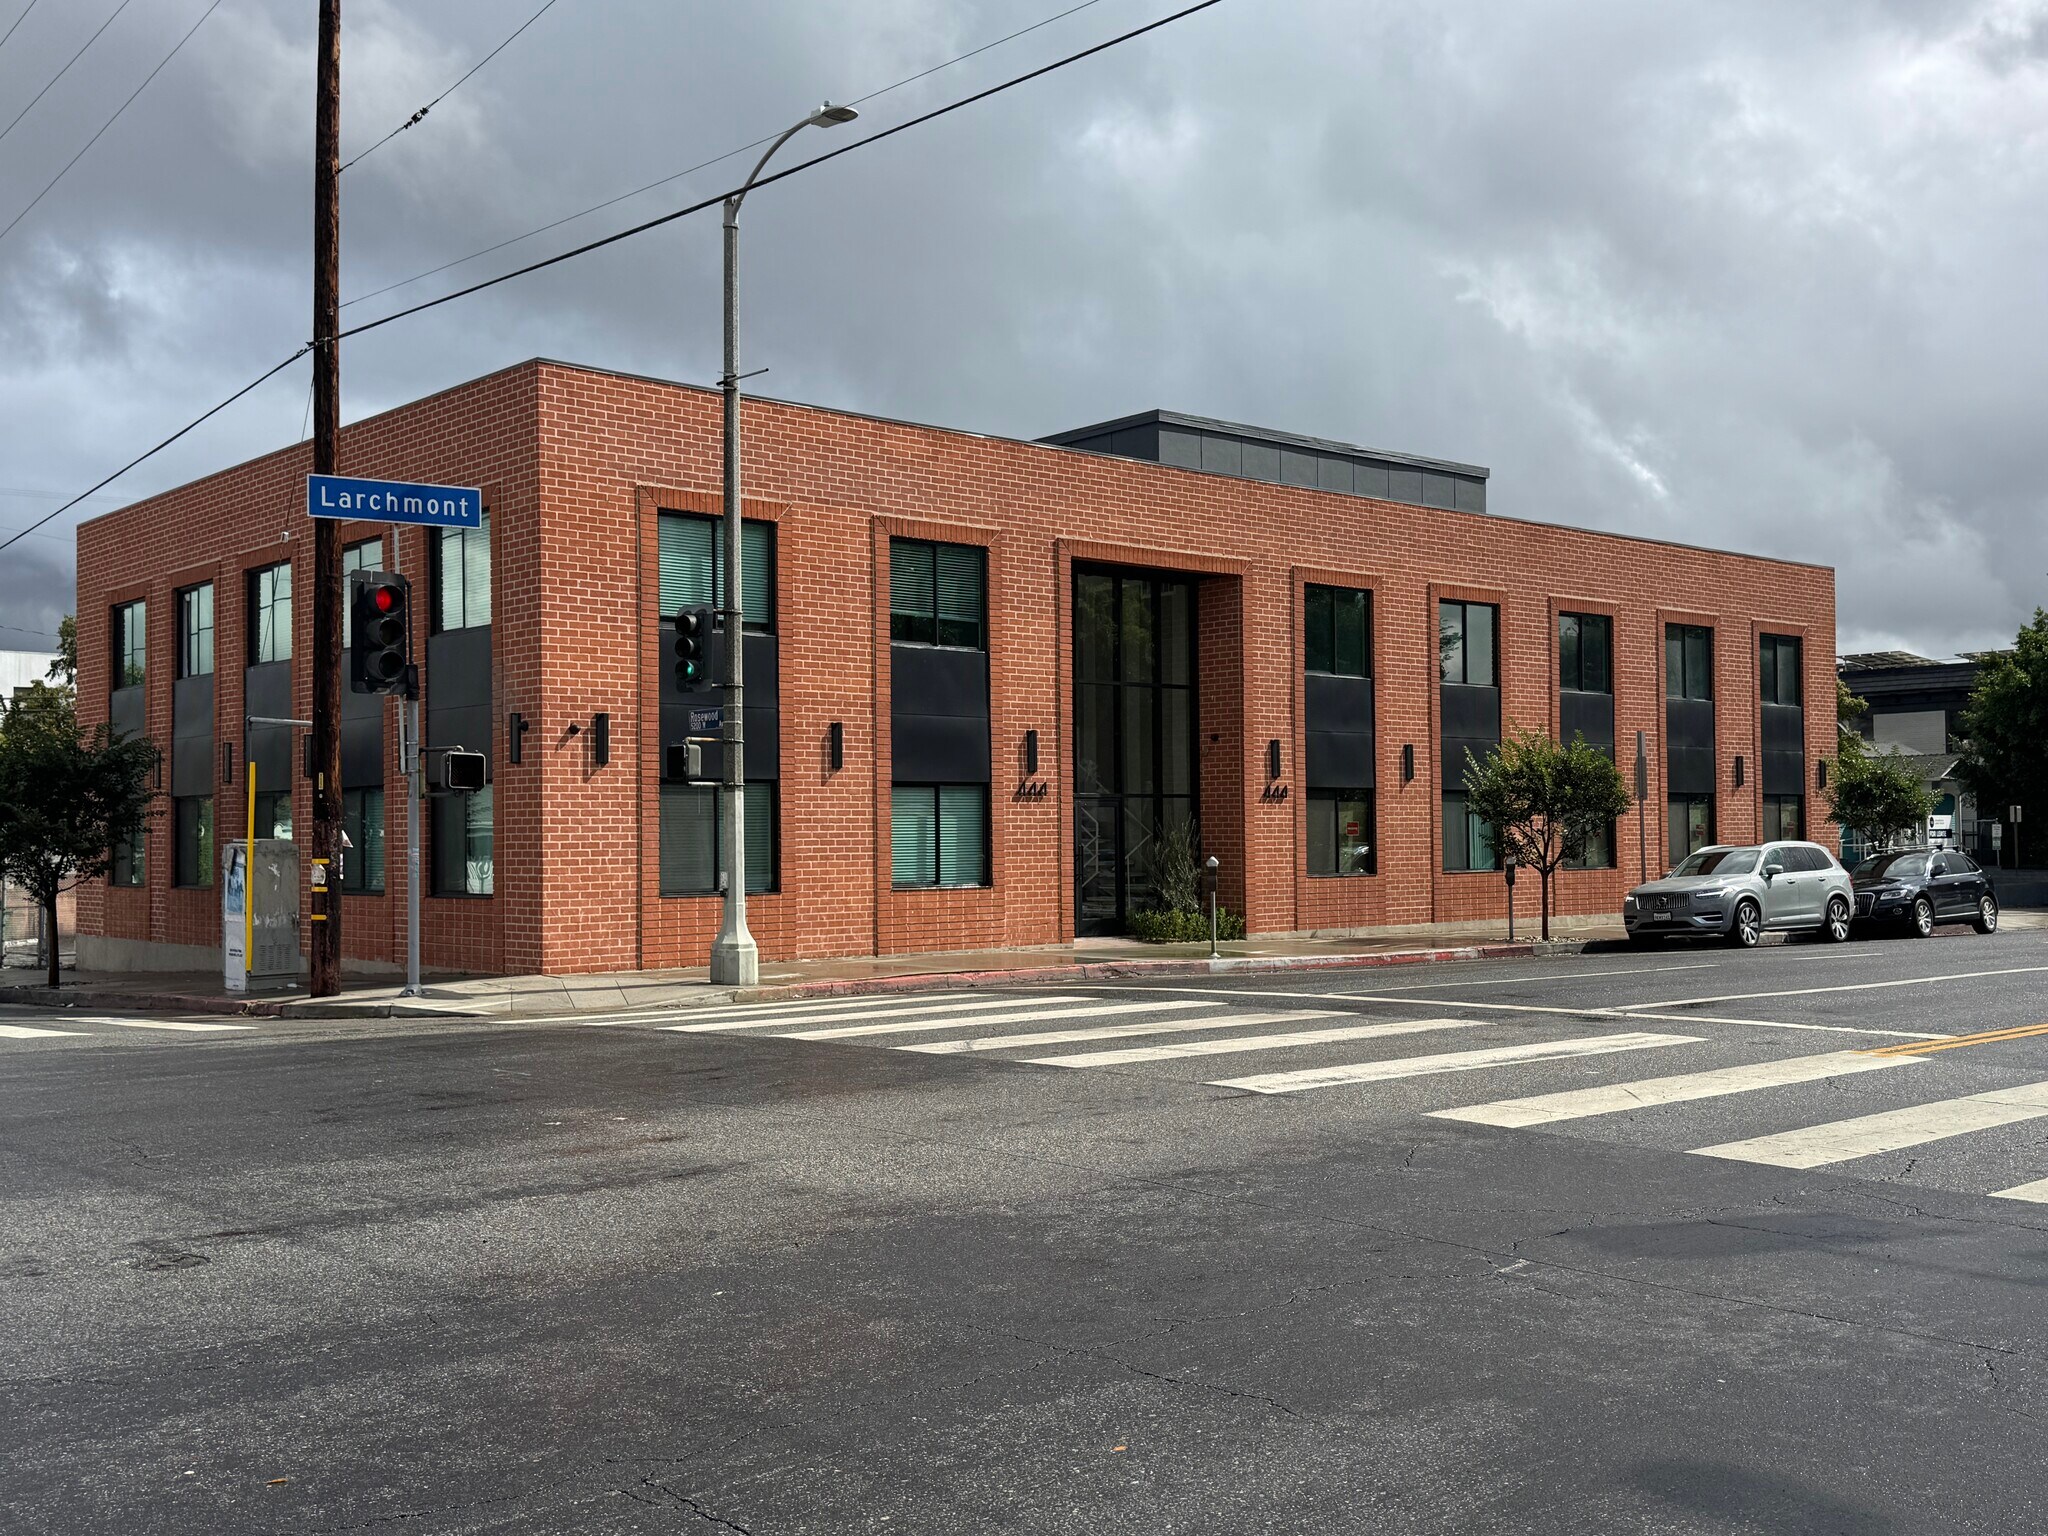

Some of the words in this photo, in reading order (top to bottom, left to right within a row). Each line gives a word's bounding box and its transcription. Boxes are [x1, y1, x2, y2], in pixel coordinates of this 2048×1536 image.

[321, 485, 469, 518] Larchmont
[690, 710, 718, 722] Rosewood
[1017, 781, 1047, 796] 444
[1263, 785, 1288, 798] 444
